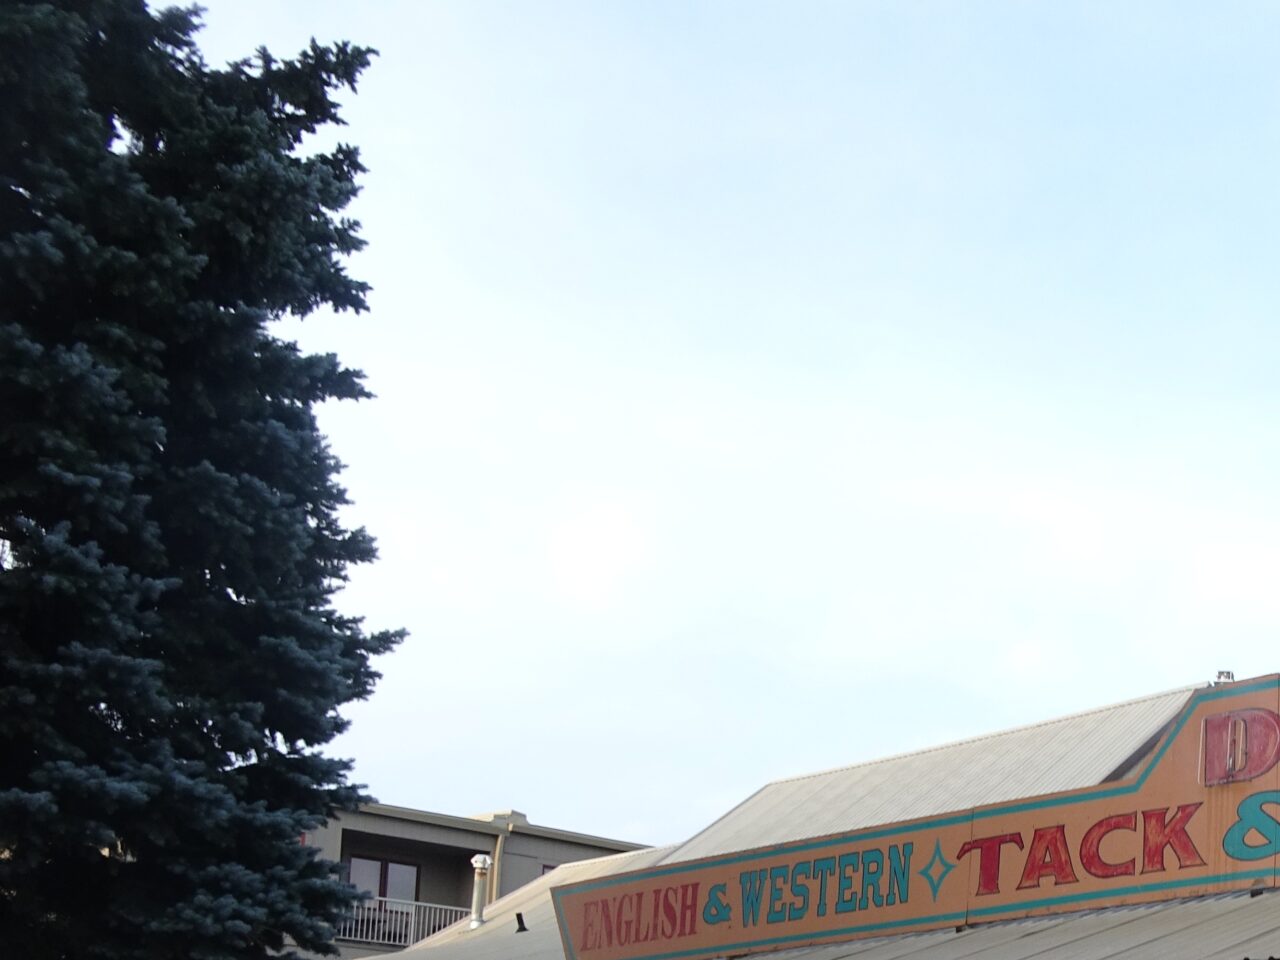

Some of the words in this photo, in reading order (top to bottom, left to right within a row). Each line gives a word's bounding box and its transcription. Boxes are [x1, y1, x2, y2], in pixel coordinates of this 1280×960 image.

[580, 881, 701, 952] ENGLISH
[702, 883, 731, 925] &
[739, 842, 913, 928] WESTERN
[956, 802, 1208, 896] TACK
